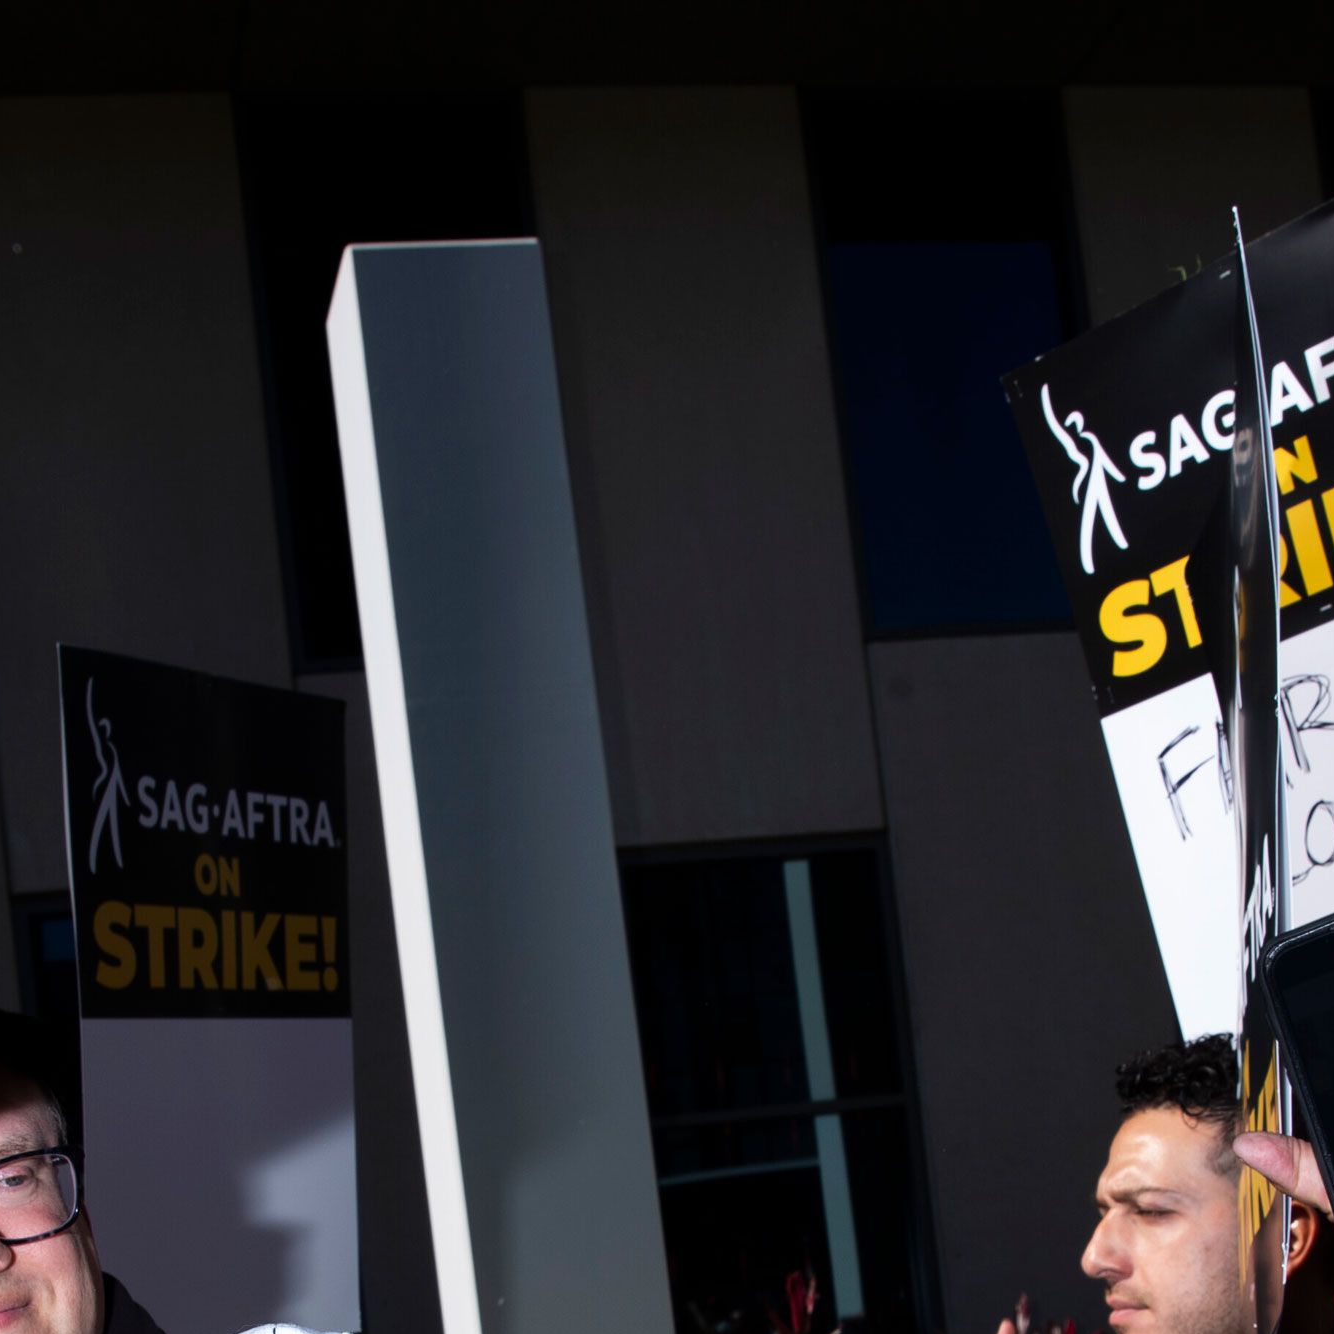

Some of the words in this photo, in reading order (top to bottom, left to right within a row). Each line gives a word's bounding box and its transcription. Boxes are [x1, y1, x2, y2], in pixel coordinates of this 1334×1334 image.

[1270, 434, 1319, 496] N
[193, 852, 241, 899] ON
[91, 899, 341, 993] STRIKE!
